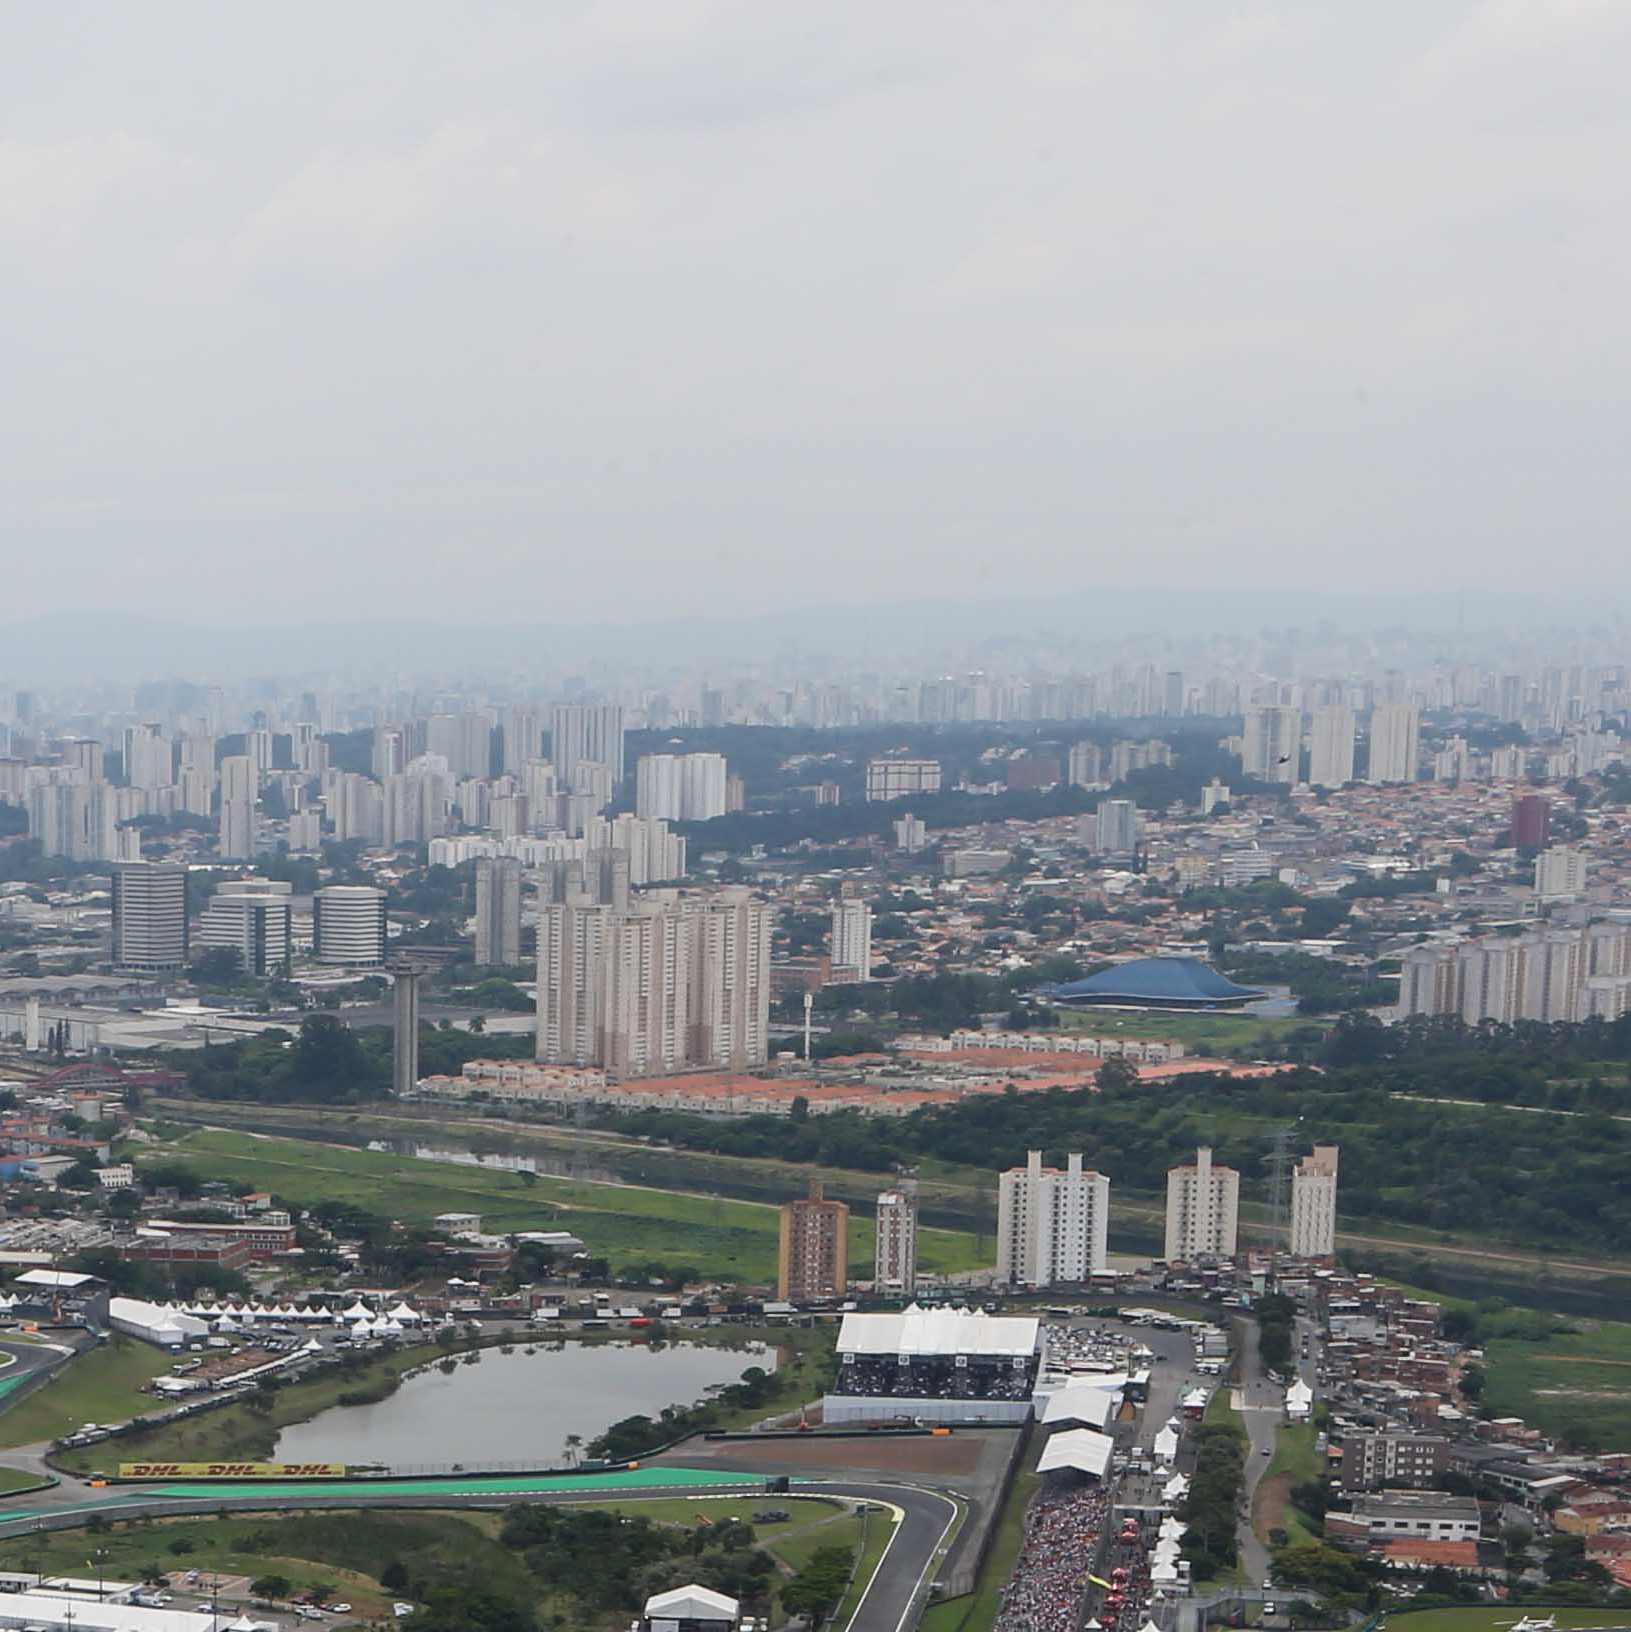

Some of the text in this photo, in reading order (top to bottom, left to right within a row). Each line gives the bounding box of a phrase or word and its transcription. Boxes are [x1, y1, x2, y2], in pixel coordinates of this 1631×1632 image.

[132, 1465, 182, 1476] DHL
[207, 1465, 257, 1476] DHL
[283, 1464, 332, 1475] DHL
